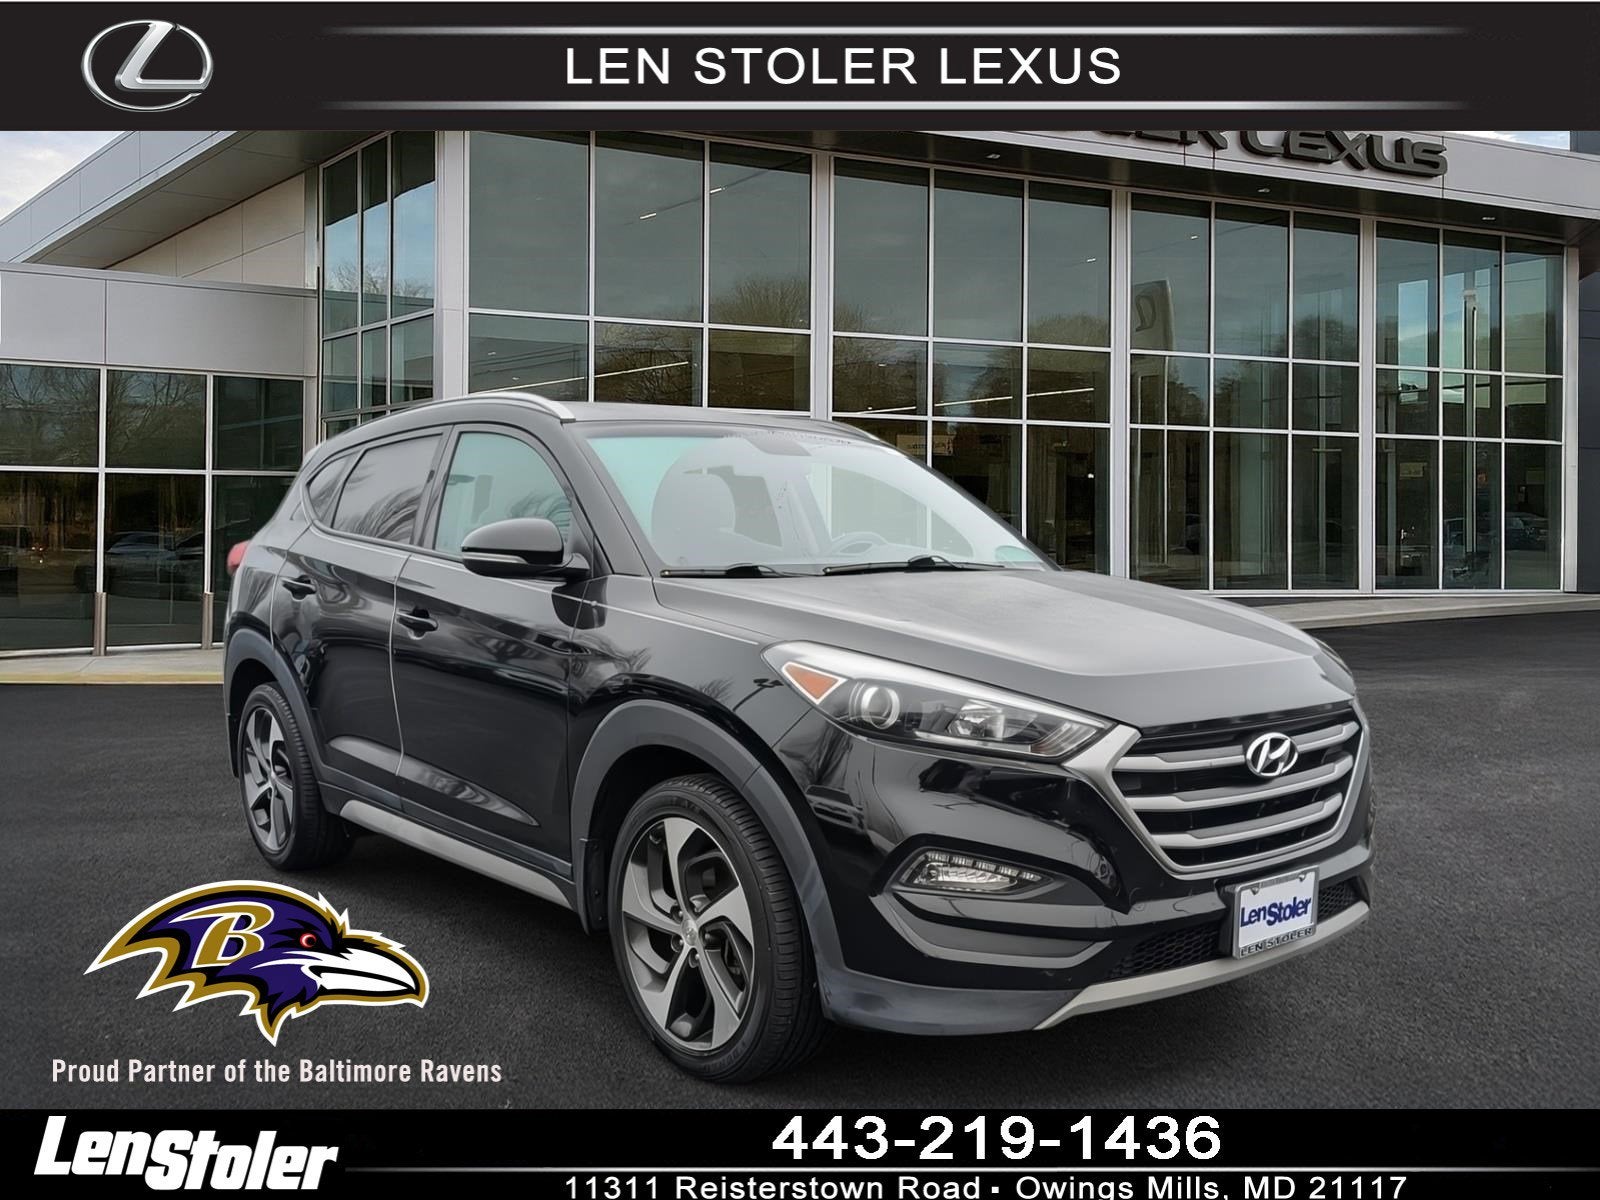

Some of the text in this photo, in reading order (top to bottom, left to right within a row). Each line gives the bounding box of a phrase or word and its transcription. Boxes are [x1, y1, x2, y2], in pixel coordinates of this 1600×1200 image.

[1239, 131, 1448, 177] LEXUS
[1240, 927, 1312, 957] LEN STOLER
